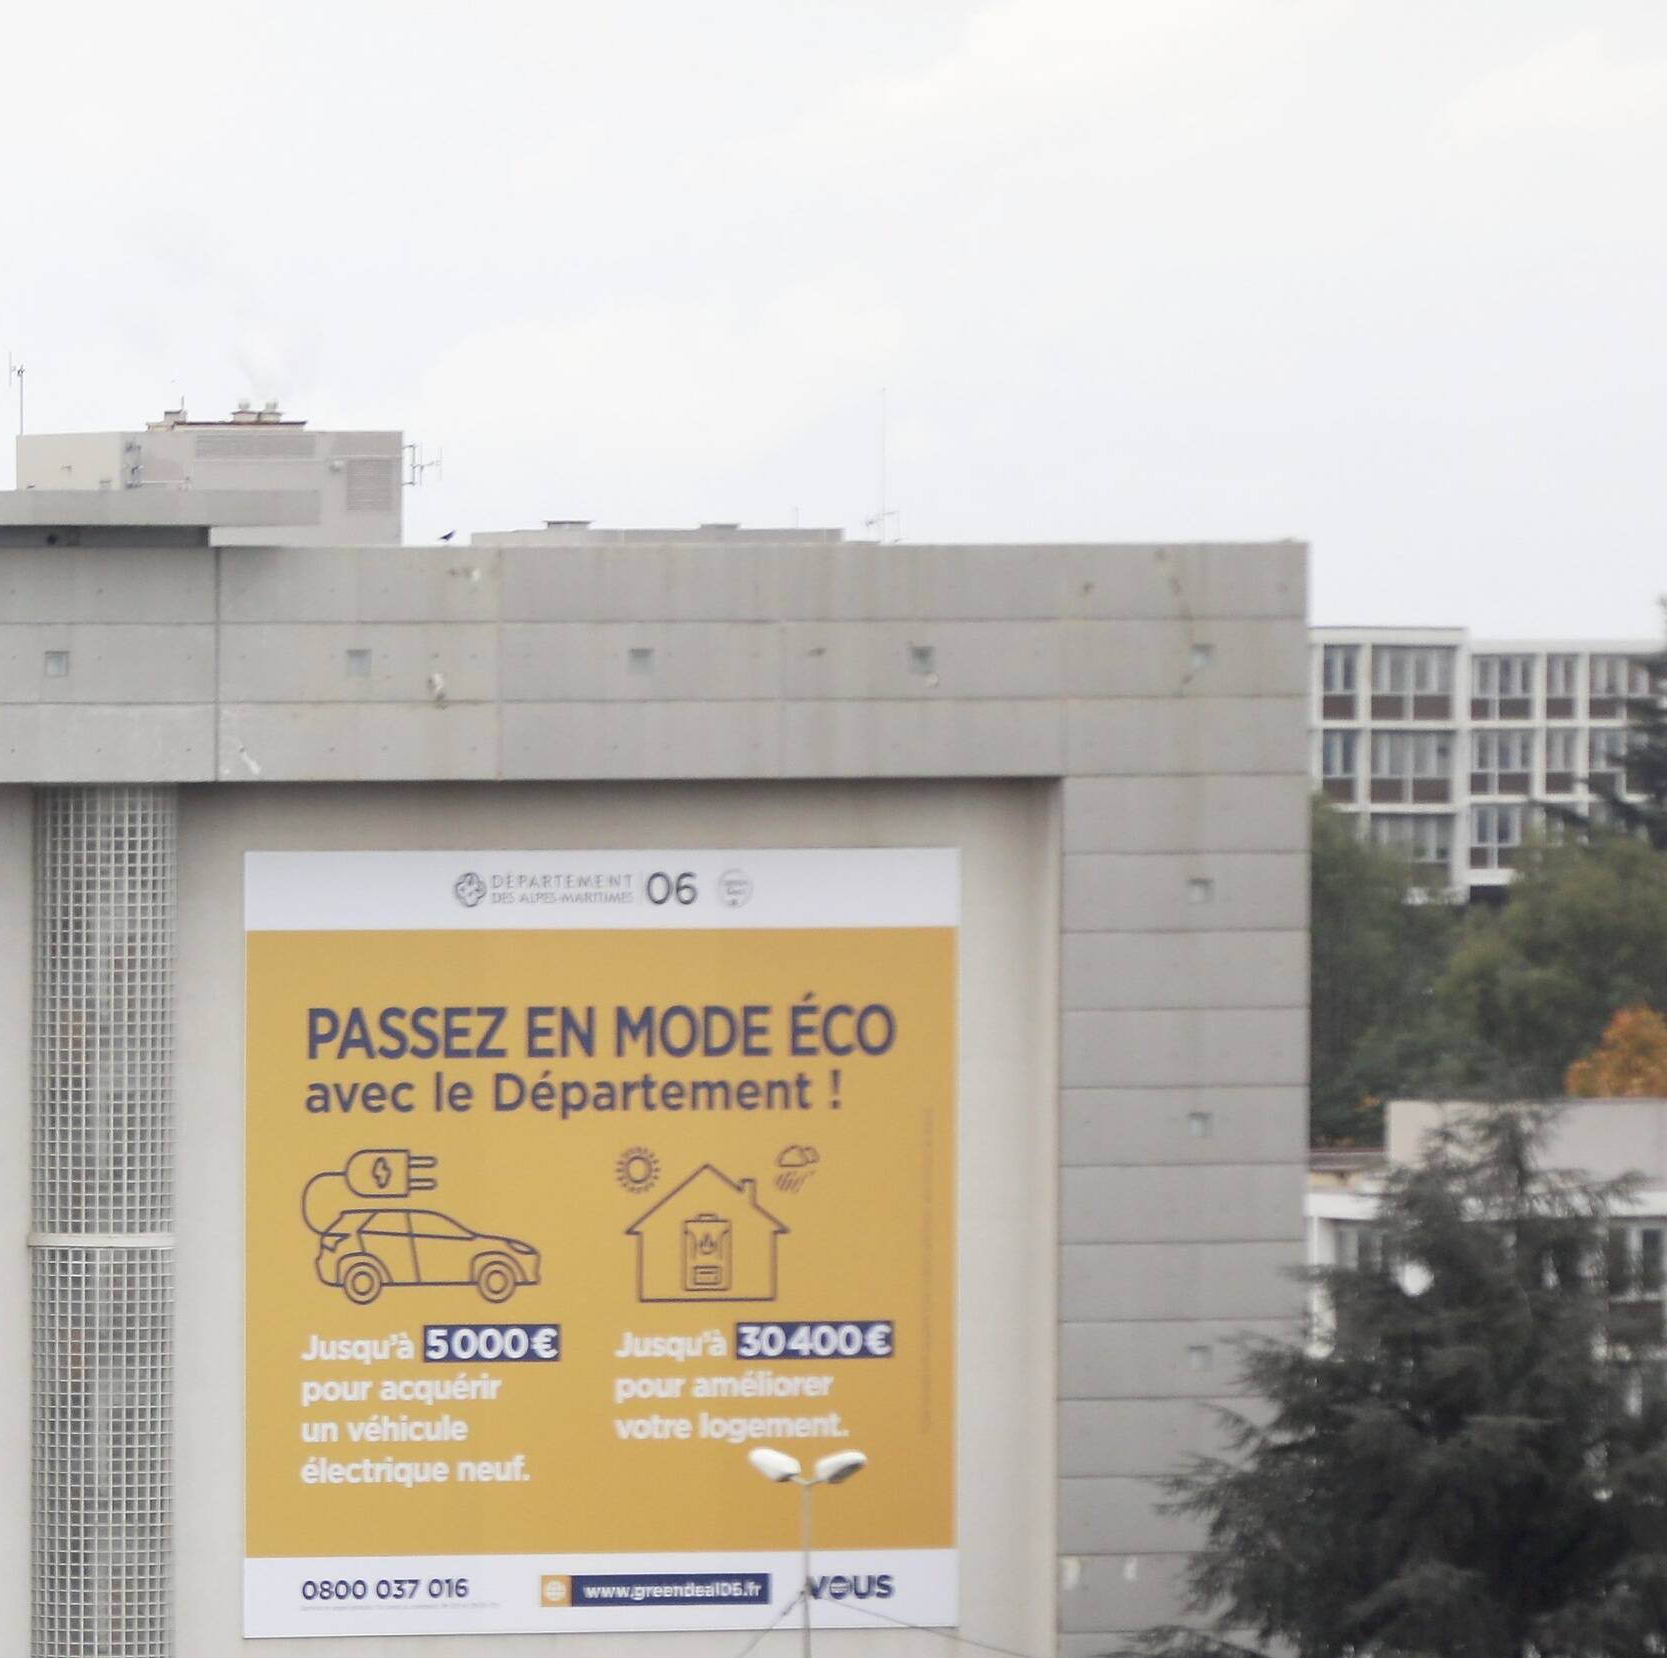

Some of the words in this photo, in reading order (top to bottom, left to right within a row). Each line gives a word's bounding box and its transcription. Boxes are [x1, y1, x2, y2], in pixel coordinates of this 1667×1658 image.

[491, 871, 634, 889] DÉPARTEMENT
[647, 871, 698, 905] 06
[307, 1006, 508, 1060] PASSEZ
[527, 1006, 595, 1058] EN
[615, 1004, 773, 1058] MODE
[790, 991, 898, 1056] ÉCO
[305, 1081, 415, 1113] avec
[435, 1071, 473, 1112] le
[494, 1069, 812, 1120] Département
[301, 1332, 415, 1365] Jusqu'à
[617, 1329, 728, 1361] Jusqu'à
[302, 1379, 373, 1406] pour
[379, 1373, 502, 1405] acquérir
[616, 1377, 685, 1403] pour
[692, 1370, 835, 1397] améliorer
[301, 1421, 339, 1442] un
[347, 1414, 468, 1442] véhicule
[616, 1413, 692, 1440] votre
[699, 1412, 849, 1443] logement.
[300, 1456, 449, 1488] électrique
[457, 1454, 531, 1483] neuf.
[302, 1579, 367, 1600] 0800
[375, 1578, 421, 1600] 037
[428, 1578, 470, 1598] 016
[809, 1574, 895, 1600] VOUS
